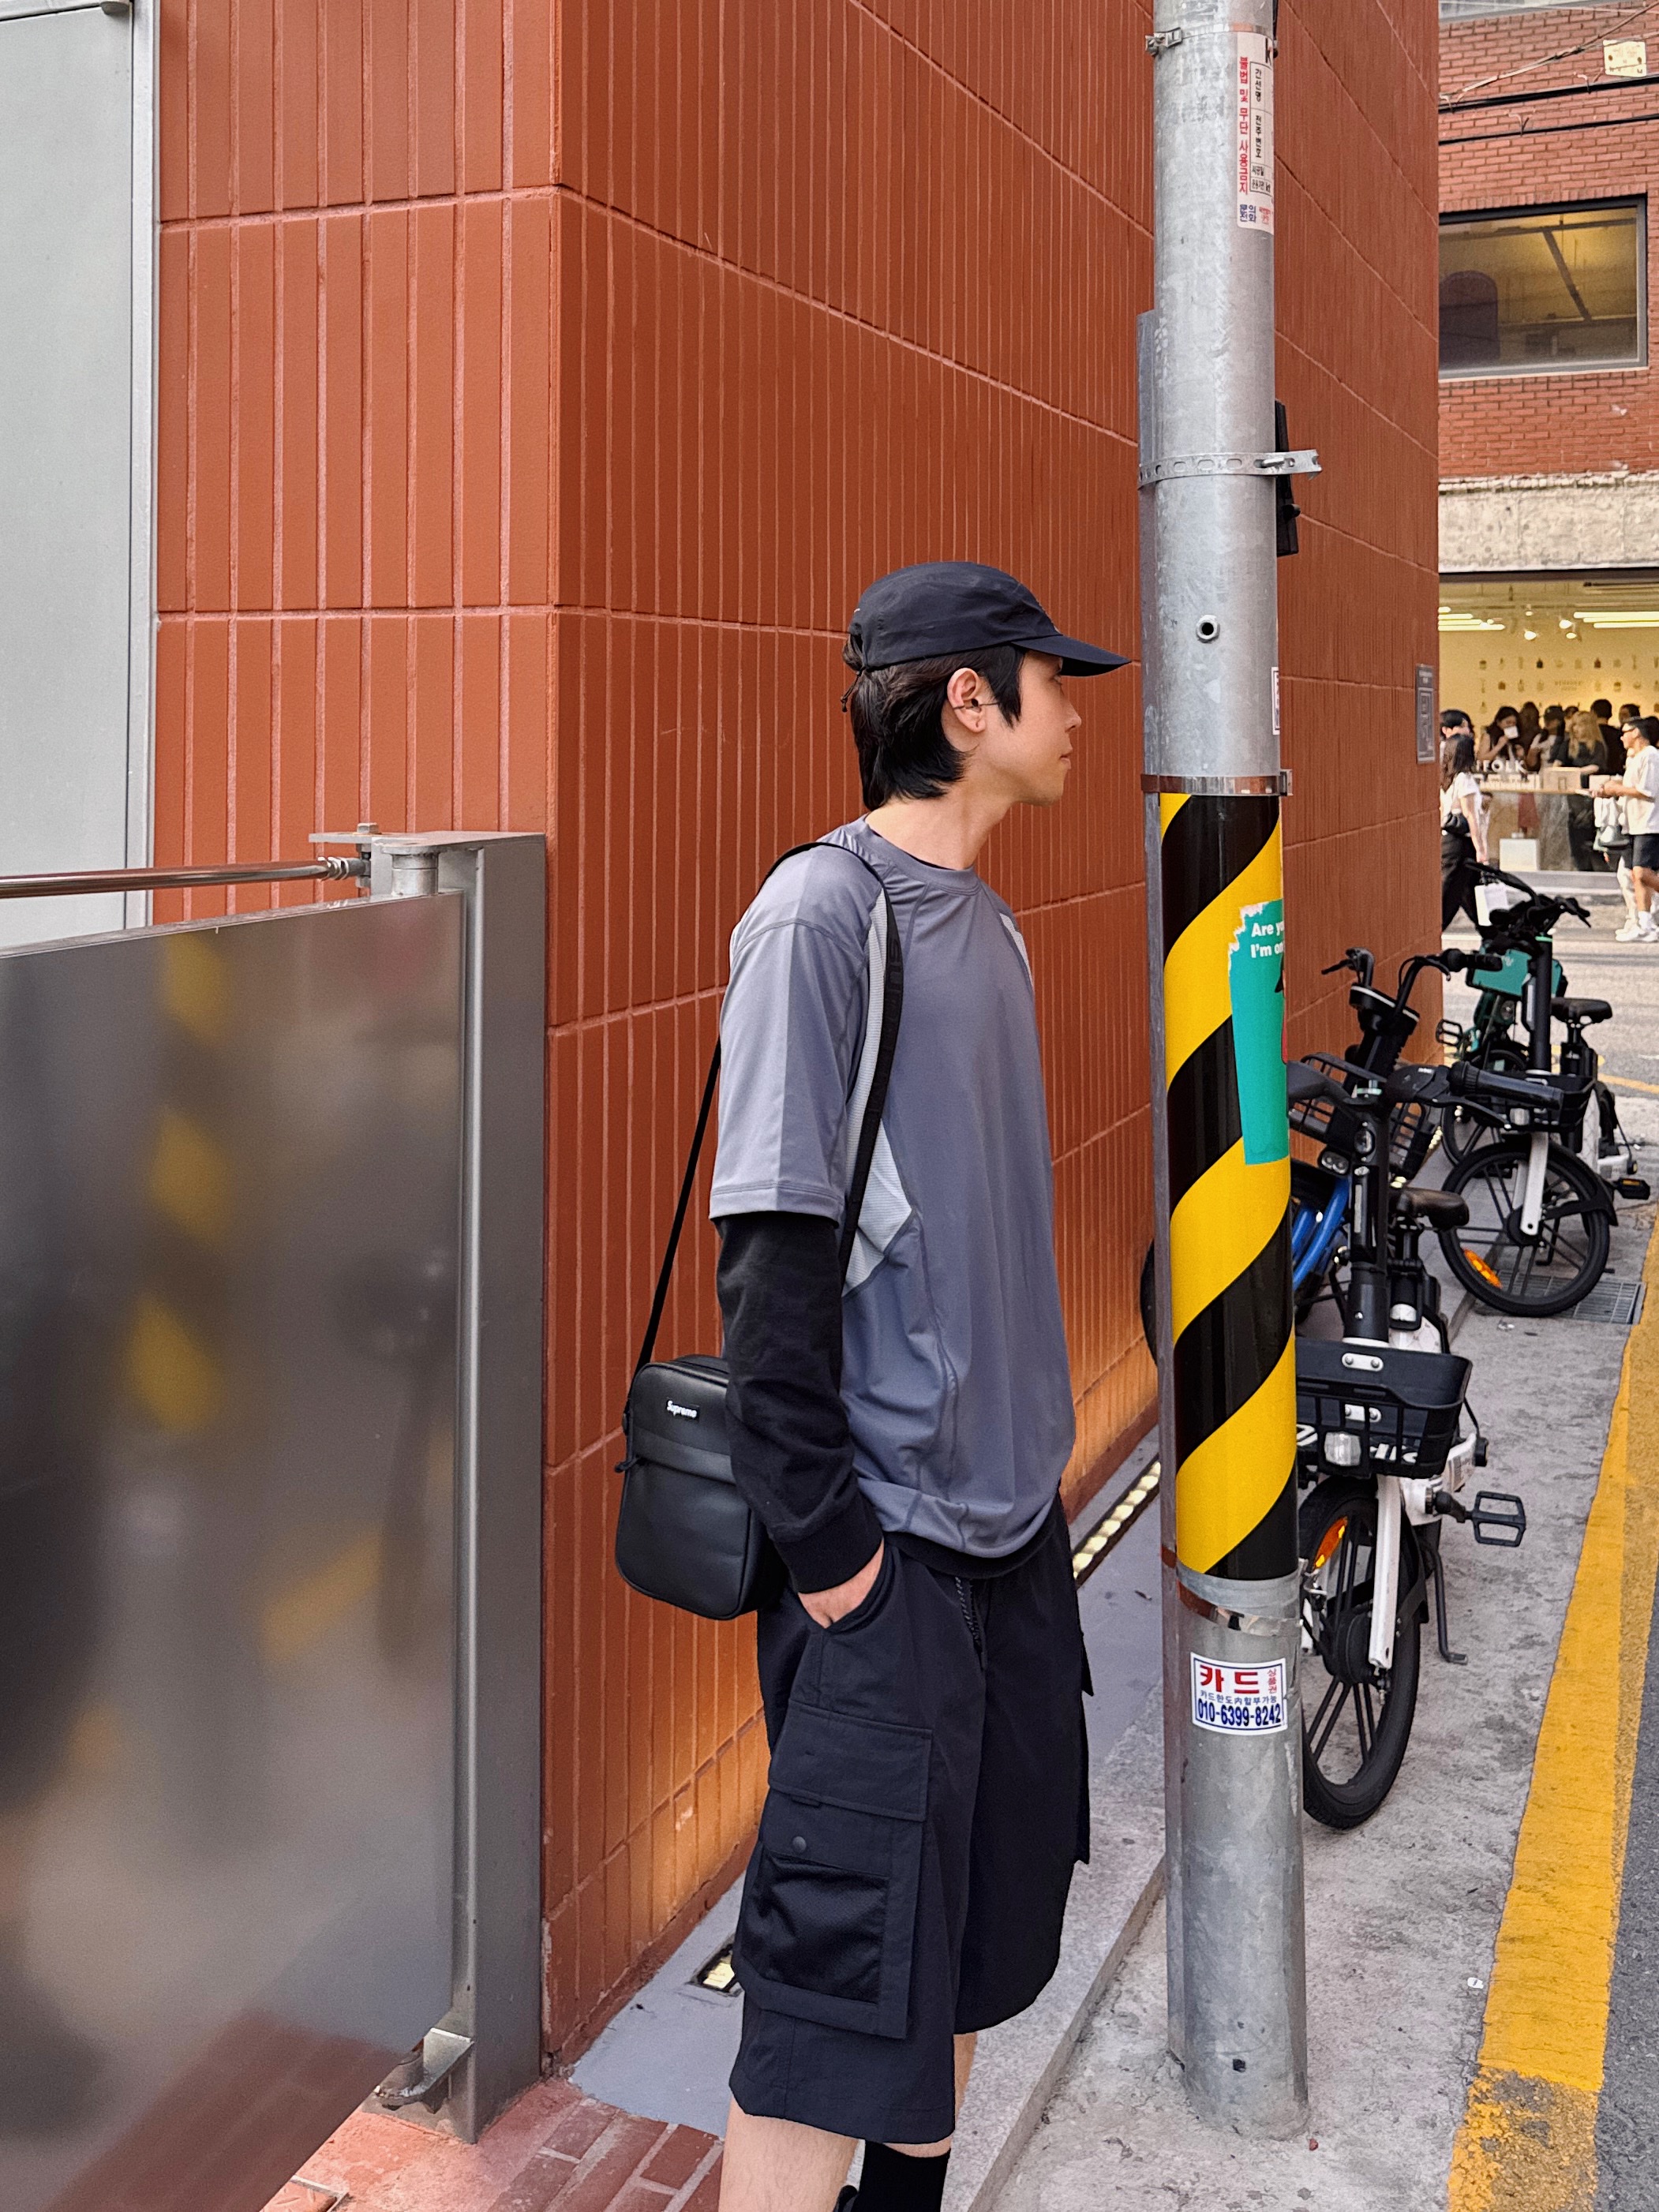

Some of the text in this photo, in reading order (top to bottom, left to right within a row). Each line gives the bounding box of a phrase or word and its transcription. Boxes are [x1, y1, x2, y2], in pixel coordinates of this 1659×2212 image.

[1239, 57, 1249, 194] 불법 및 무단 사용금지
[1251, 923, 1274, 938] Are
[1250, 944, 1272, 959] I'm
[666, 1400, 698, 1418] Supreme
[1200, 1664, 1260, 1694] 카드
[1197, 1697, 1282, 1727] 010-6399-8242
